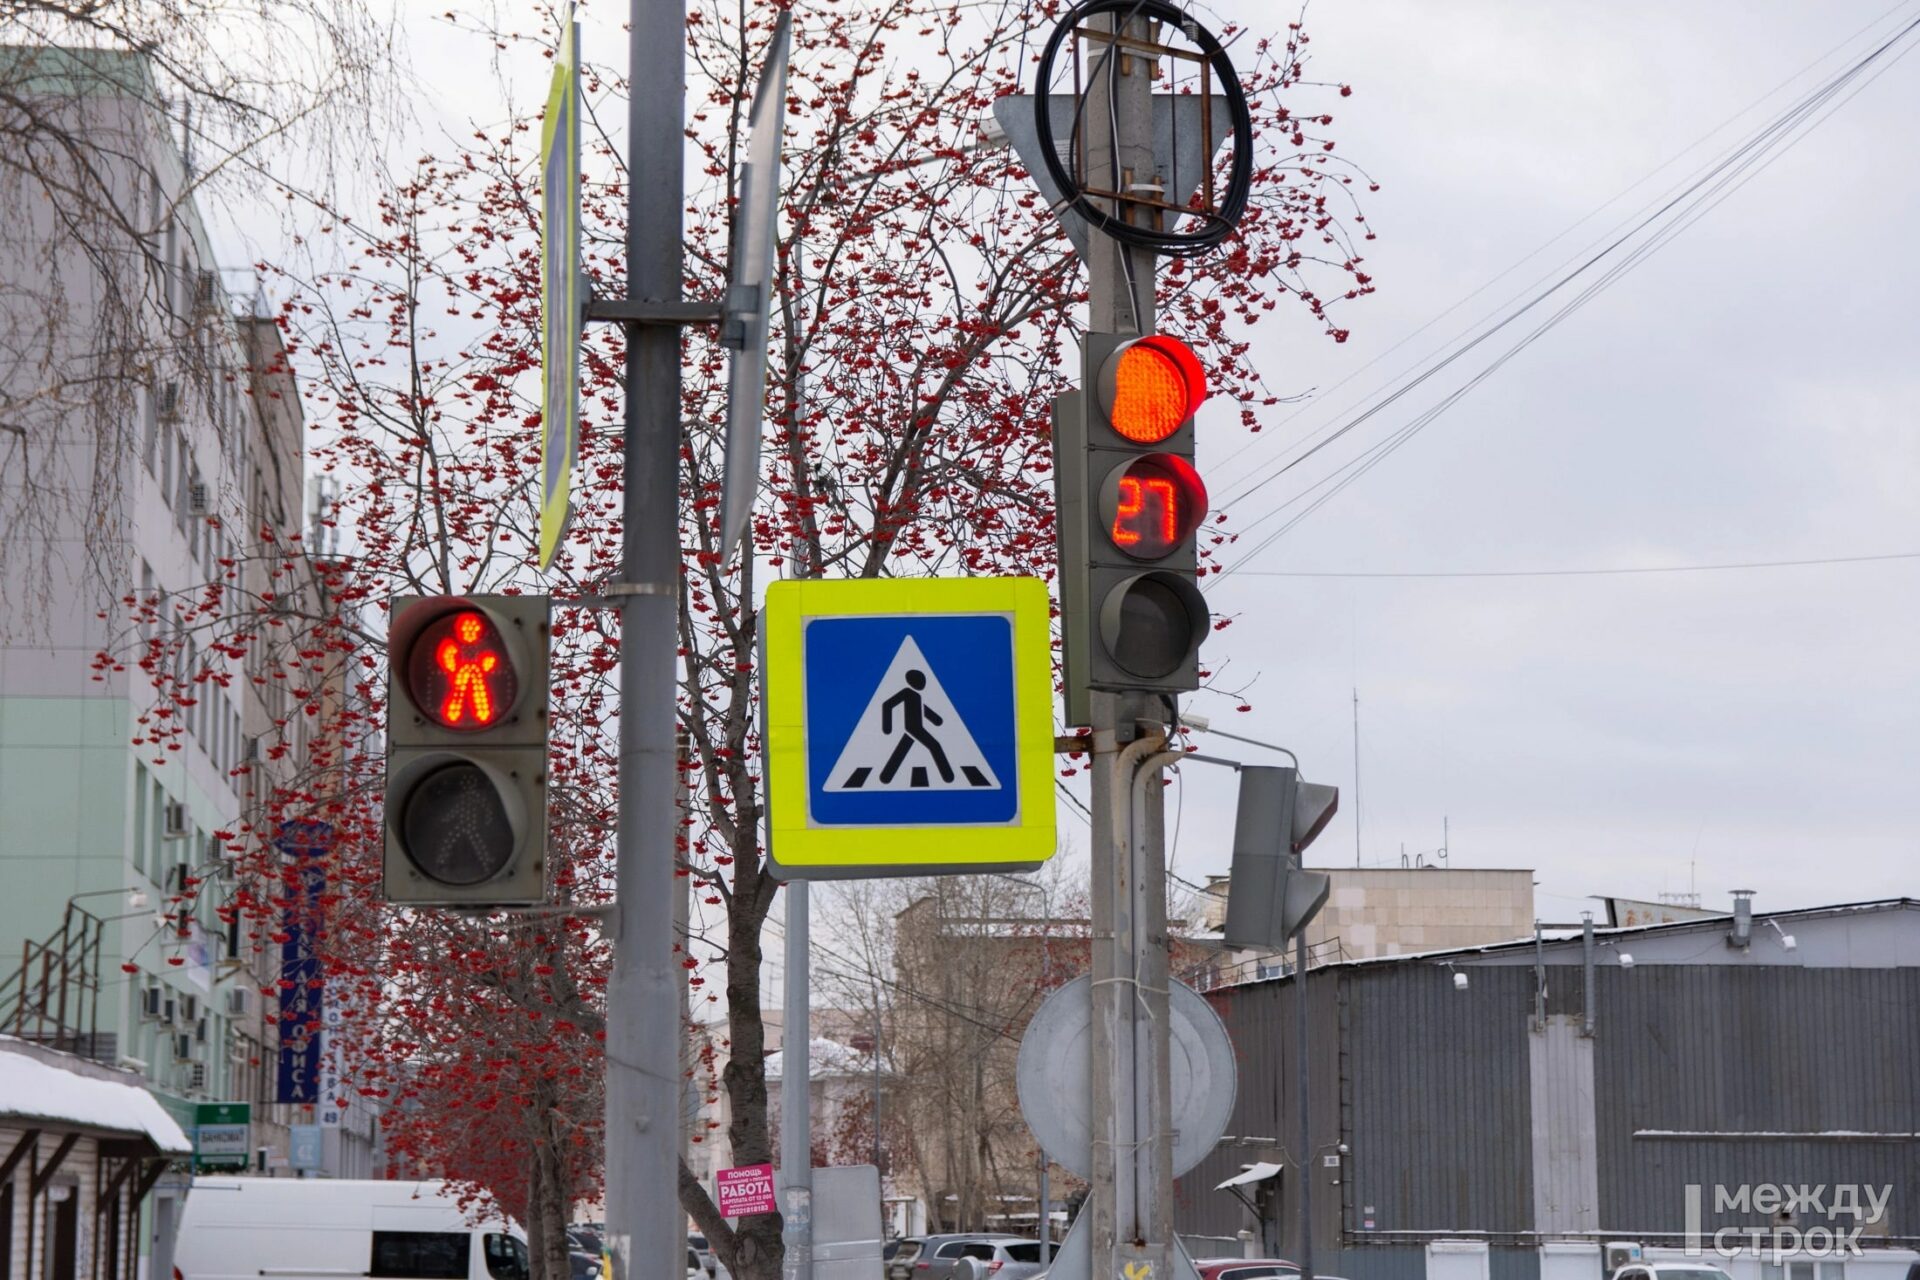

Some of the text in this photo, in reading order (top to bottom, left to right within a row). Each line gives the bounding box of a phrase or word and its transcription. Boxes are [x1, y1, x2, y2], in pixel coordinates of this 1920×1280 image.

[1113, 477, 1175, 543] 27
[728, 1169, 762, 1179] ПОМОЩЬ
[721, 1181, 771, 1198] РАБОТА
